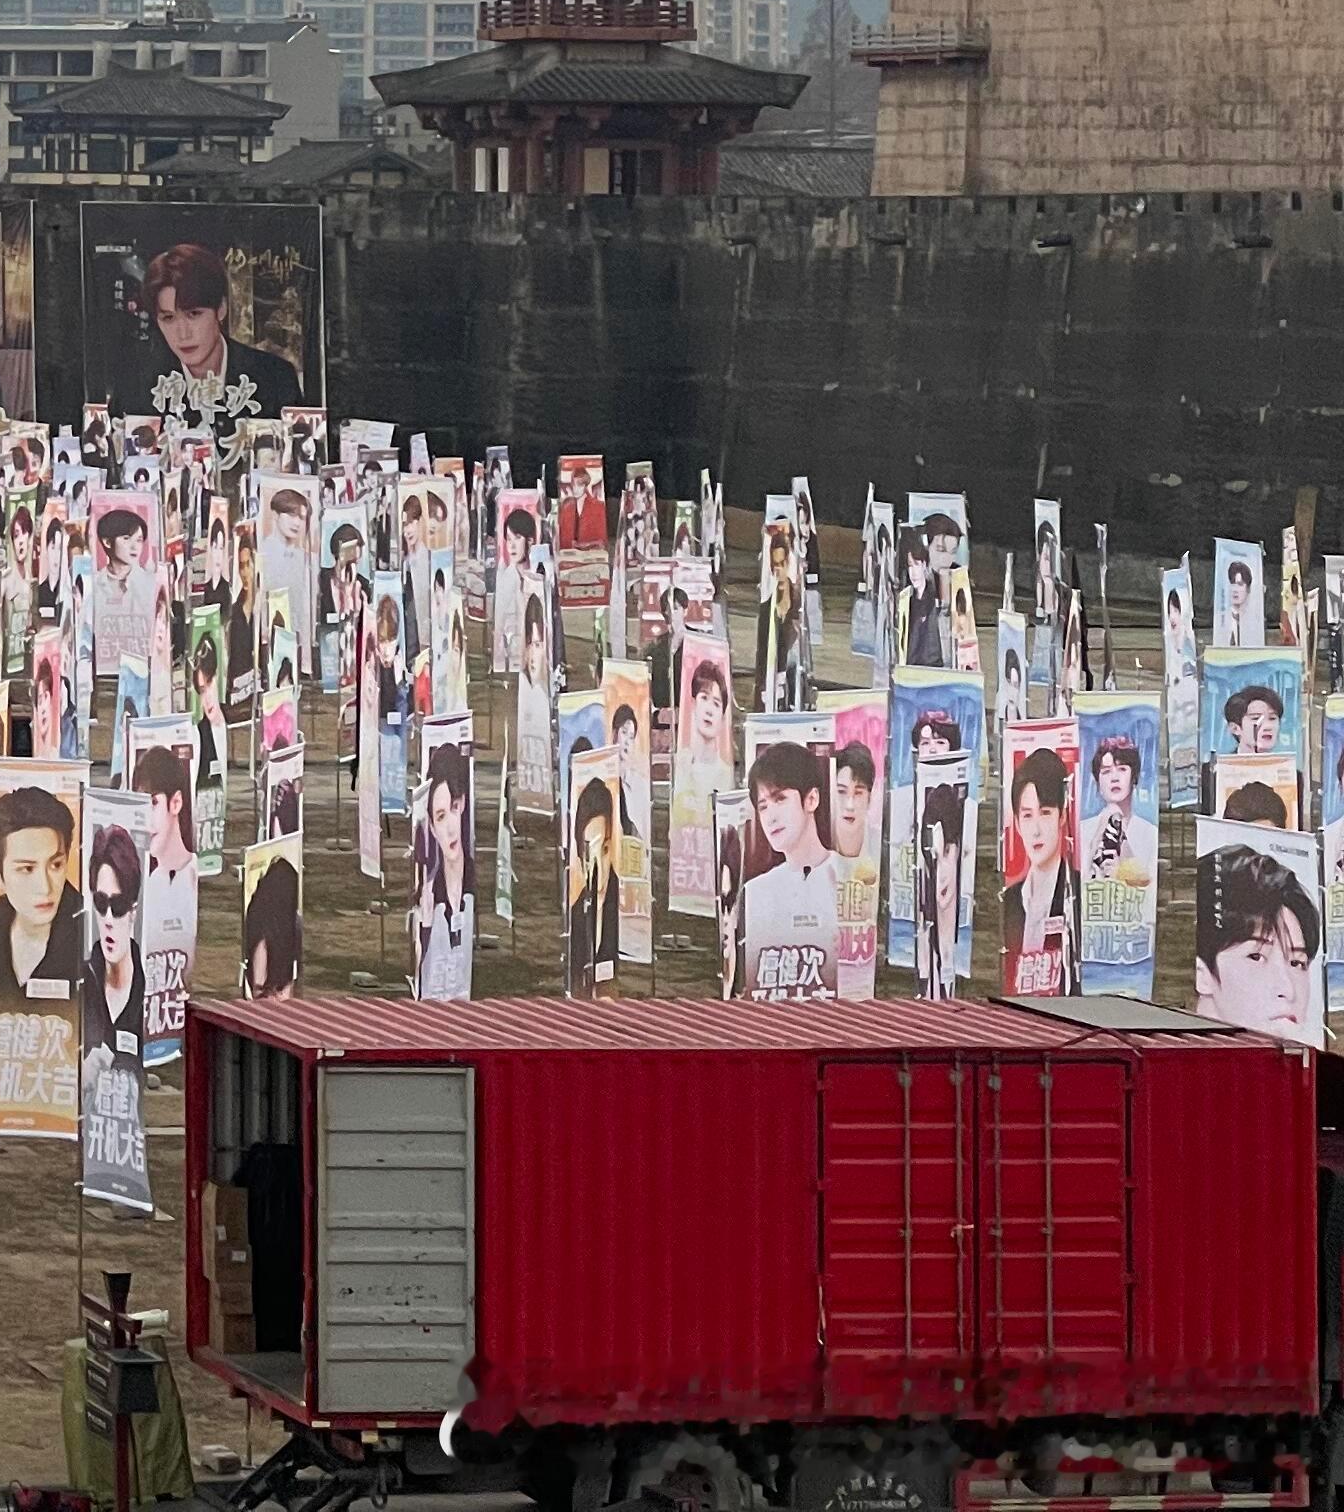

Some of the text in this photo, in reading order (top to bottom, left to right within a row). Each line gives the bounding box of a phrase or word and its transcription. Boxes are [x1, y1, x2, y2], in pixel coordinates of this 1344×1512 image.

[151, 370, 262, 423] 檀健次
[757, 945, 826, 988] 檀健次
[144, 990, 190, 1035] 机大吉
